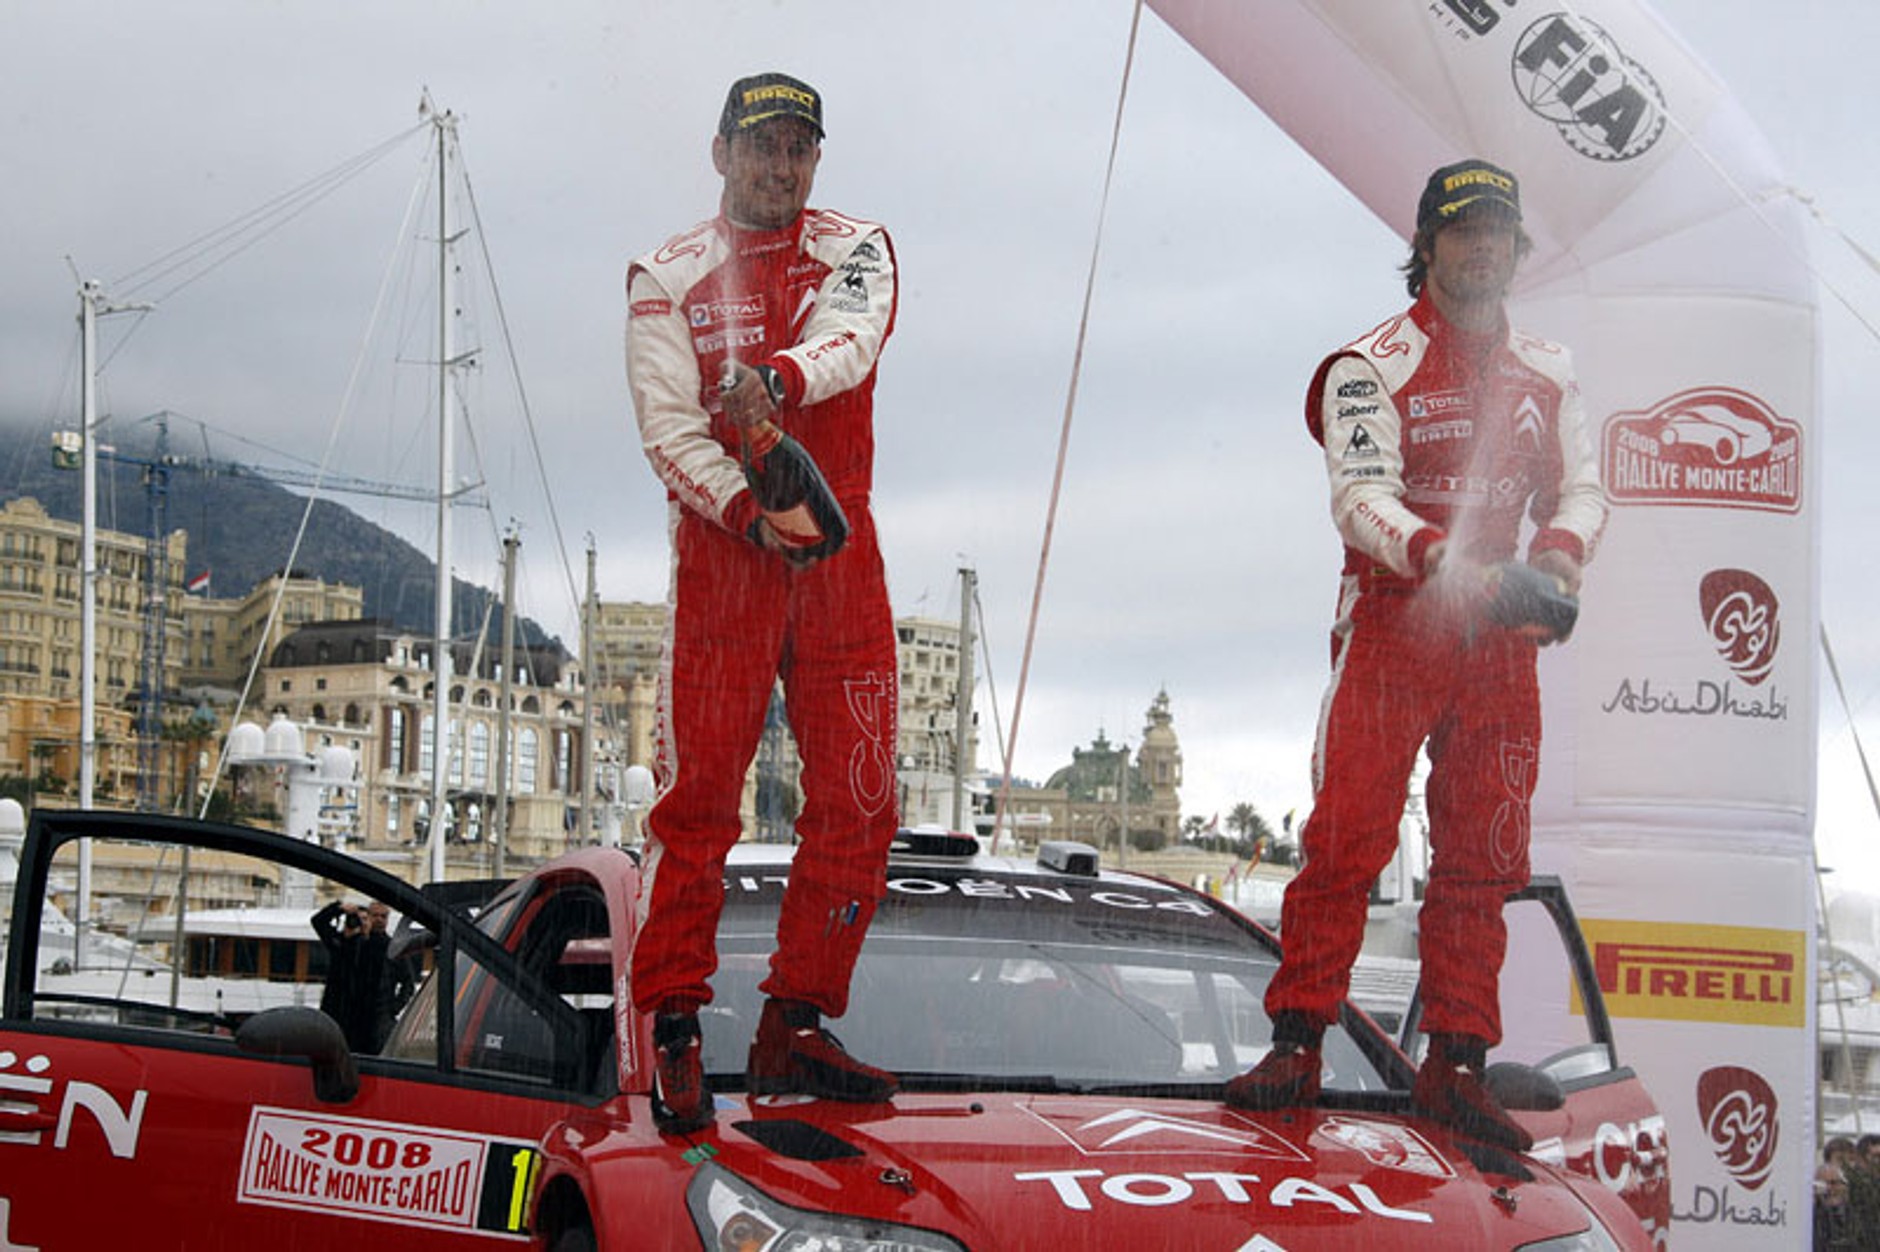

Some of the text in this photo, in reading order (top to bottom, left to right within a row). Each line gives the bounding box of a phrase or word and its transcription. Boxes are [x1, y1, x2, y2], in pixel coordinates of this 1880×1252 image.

[711, 302, 762, 317] TOTAL
[1616, 446, 1679, 490] RALLYE
[1595, 942, 1794, 1004] PIRELLI
[254, 1131, 322, 1197] RALLYE
[301, 1128, 432, 1170] 2008
[507, 1149, 532, 1231] 1
[1014, 1169, 1434, 1223] TOTAL
